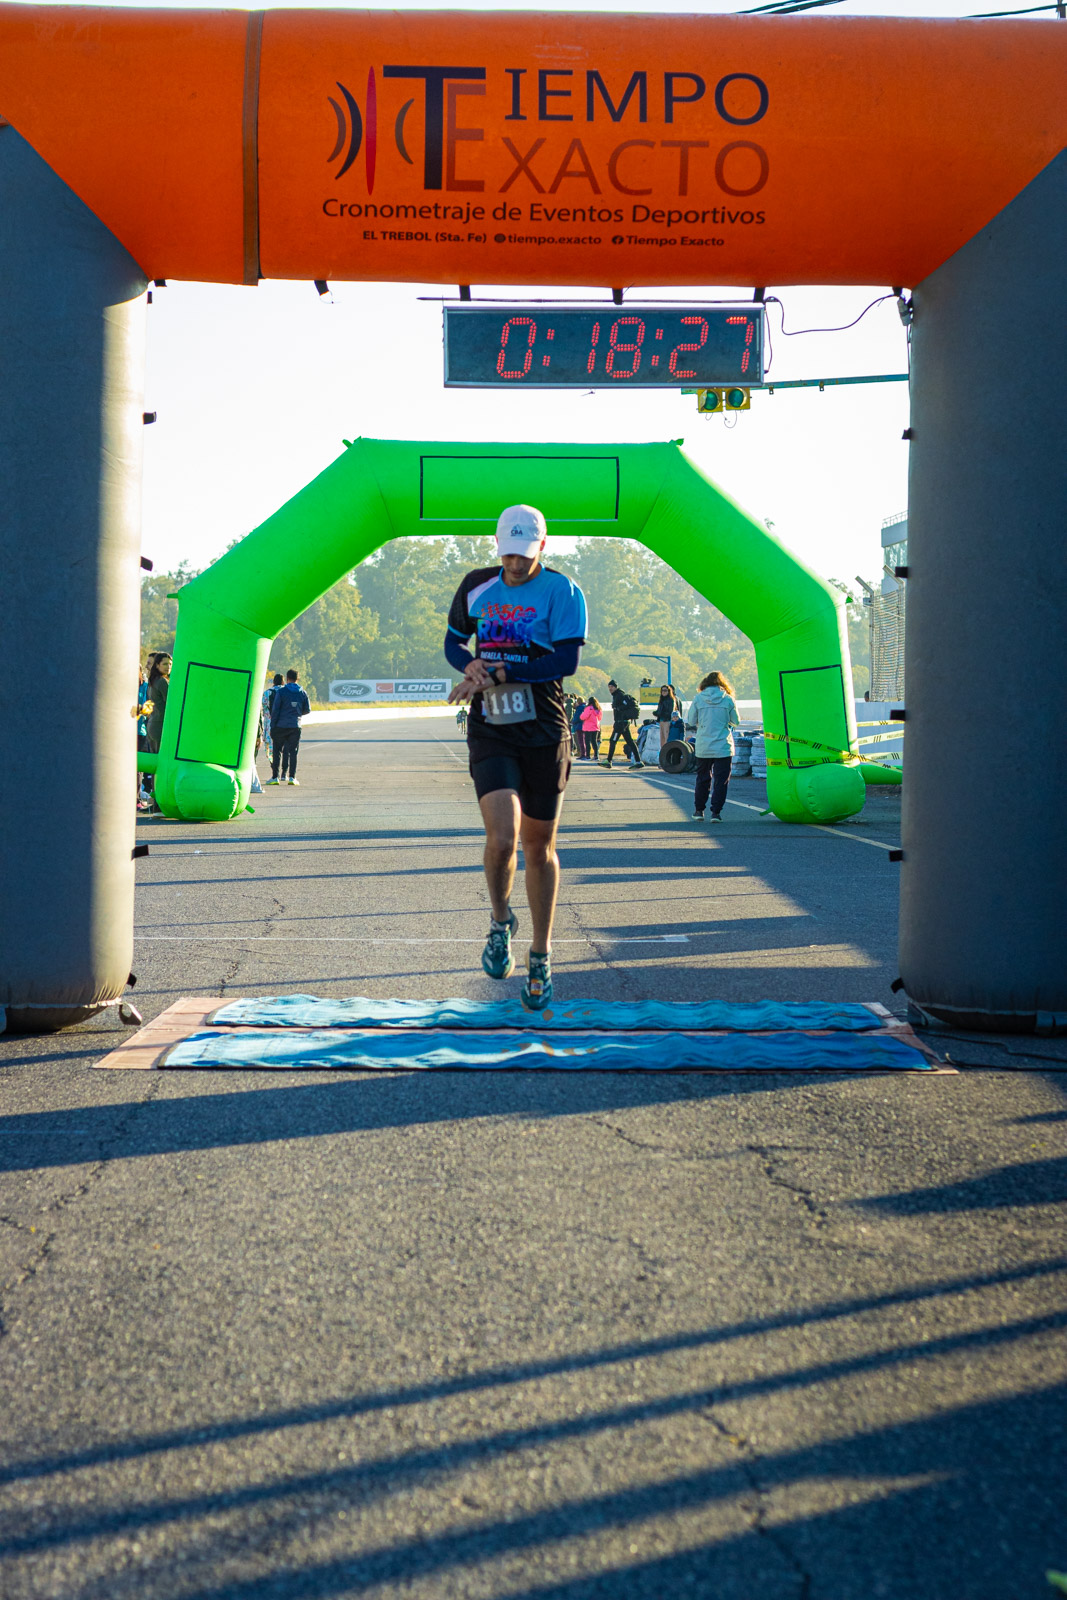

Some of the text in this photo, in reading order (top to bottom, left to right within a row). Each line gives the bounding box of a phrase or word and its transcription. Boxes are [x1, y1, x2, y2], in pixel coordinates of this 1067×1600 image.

[322, 198, 766, 227] Cronometraje de Eventos Deportivos
[363, 231, 378, 240] EL
[380, 231, 432, 241] TREBOL
[435, 232, 465, 243] (Sta.
[467, 232, 487, 243] Fe)
[626, 235, 677, 247] Tiempo
[681, 236, 725, 246] Exacto
[496, 316, 754, 378] 0:18:27
[339, 684, 443, 696] Ford LONG
[490, 691, 525, 715] 118
